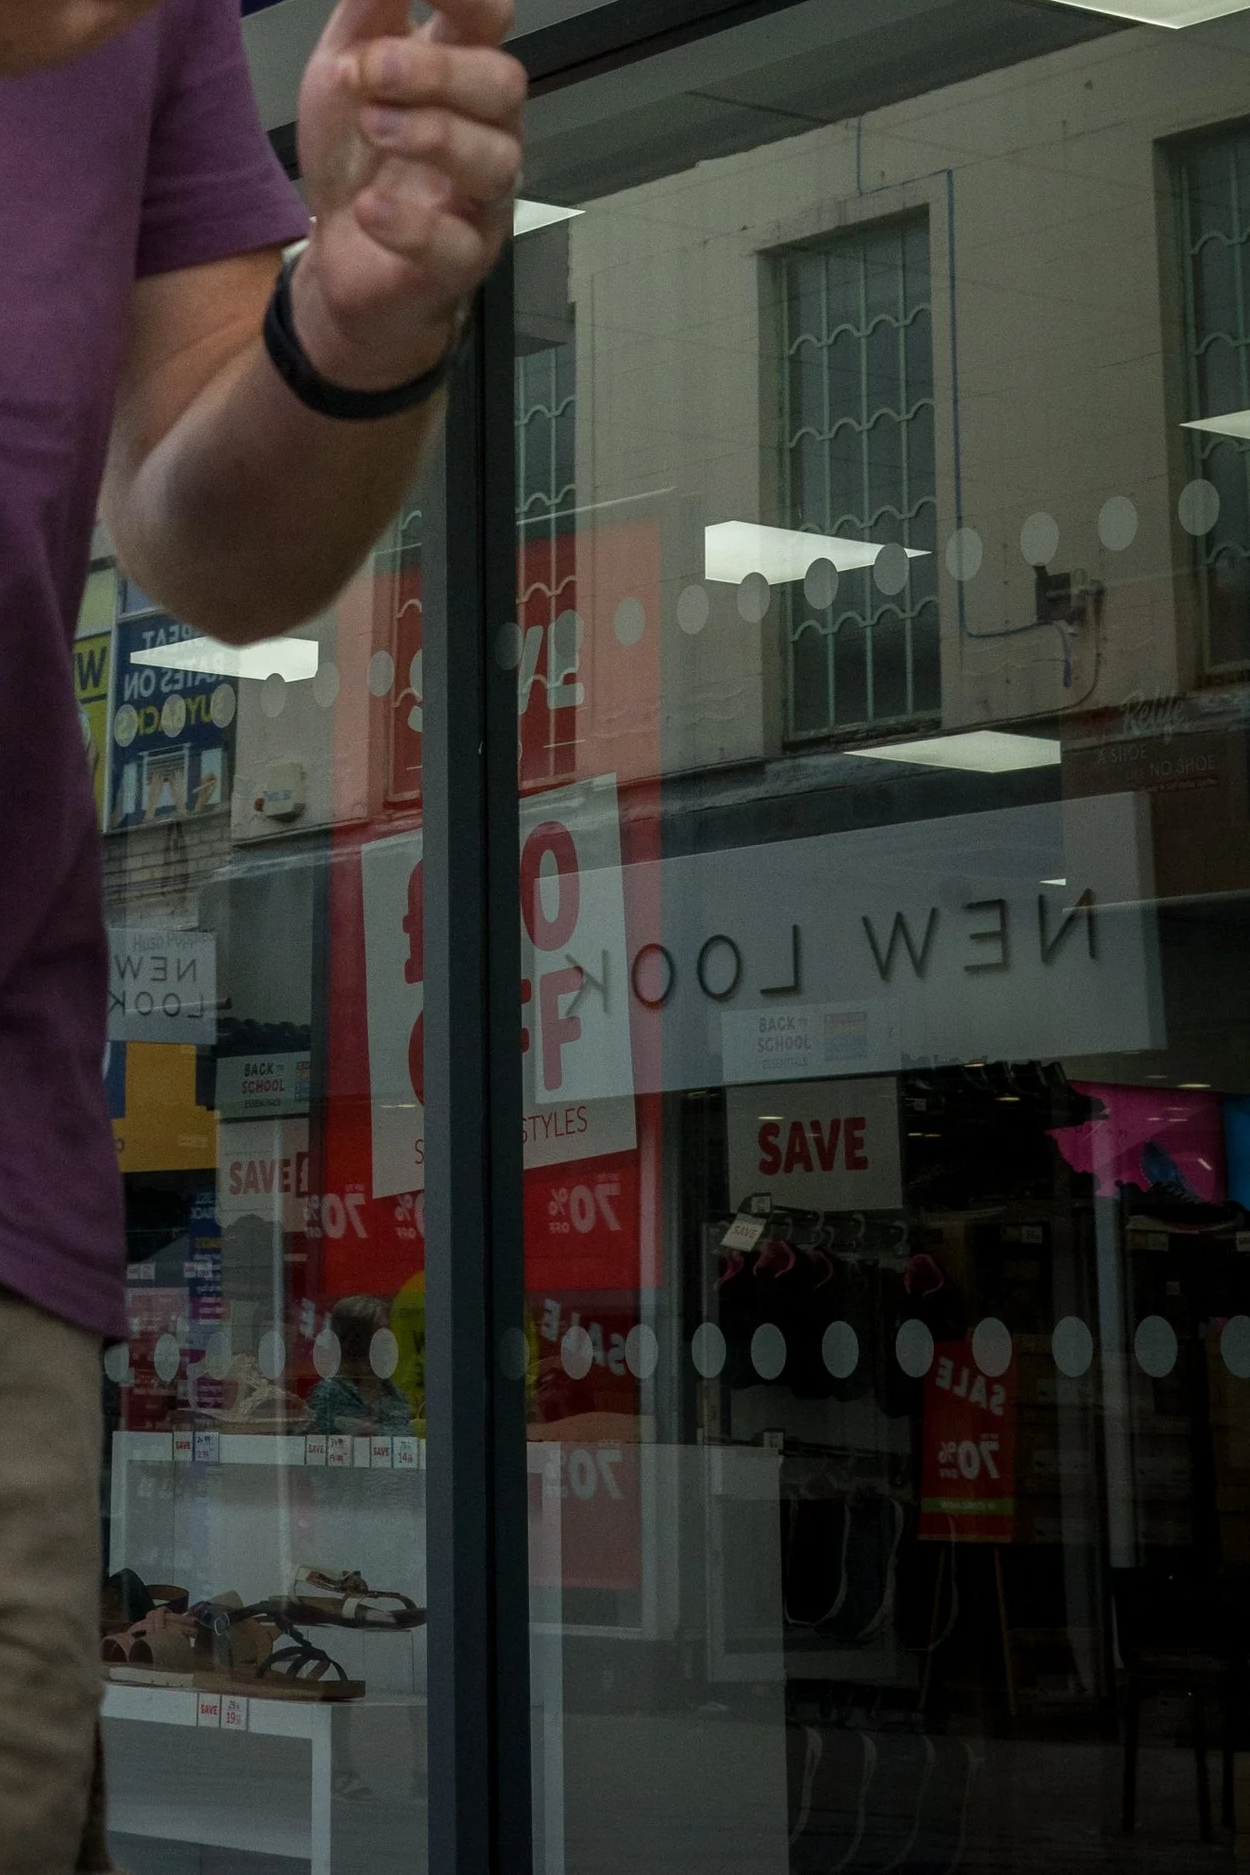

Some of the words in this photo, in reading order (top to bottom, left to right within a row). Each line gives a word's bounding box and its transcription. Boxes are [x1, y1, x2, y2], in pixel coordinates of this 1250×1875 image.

[759, 1015, 795, 1033] BACK
[757, 1034, 812, 1054] SCHOOL
[244, 1062, 274, 1077] BACK
[241, 1078, 285, 1094] SCHOOL
[758, 1117, 868, 1175] SAVE
[229, 1158, 291, 1195] SAVE
[175, 1440, 191, 1450] SAVE
[373, 1446, 390, 1457] SAVE
[200, 1704, 218, 1715] SAVE
